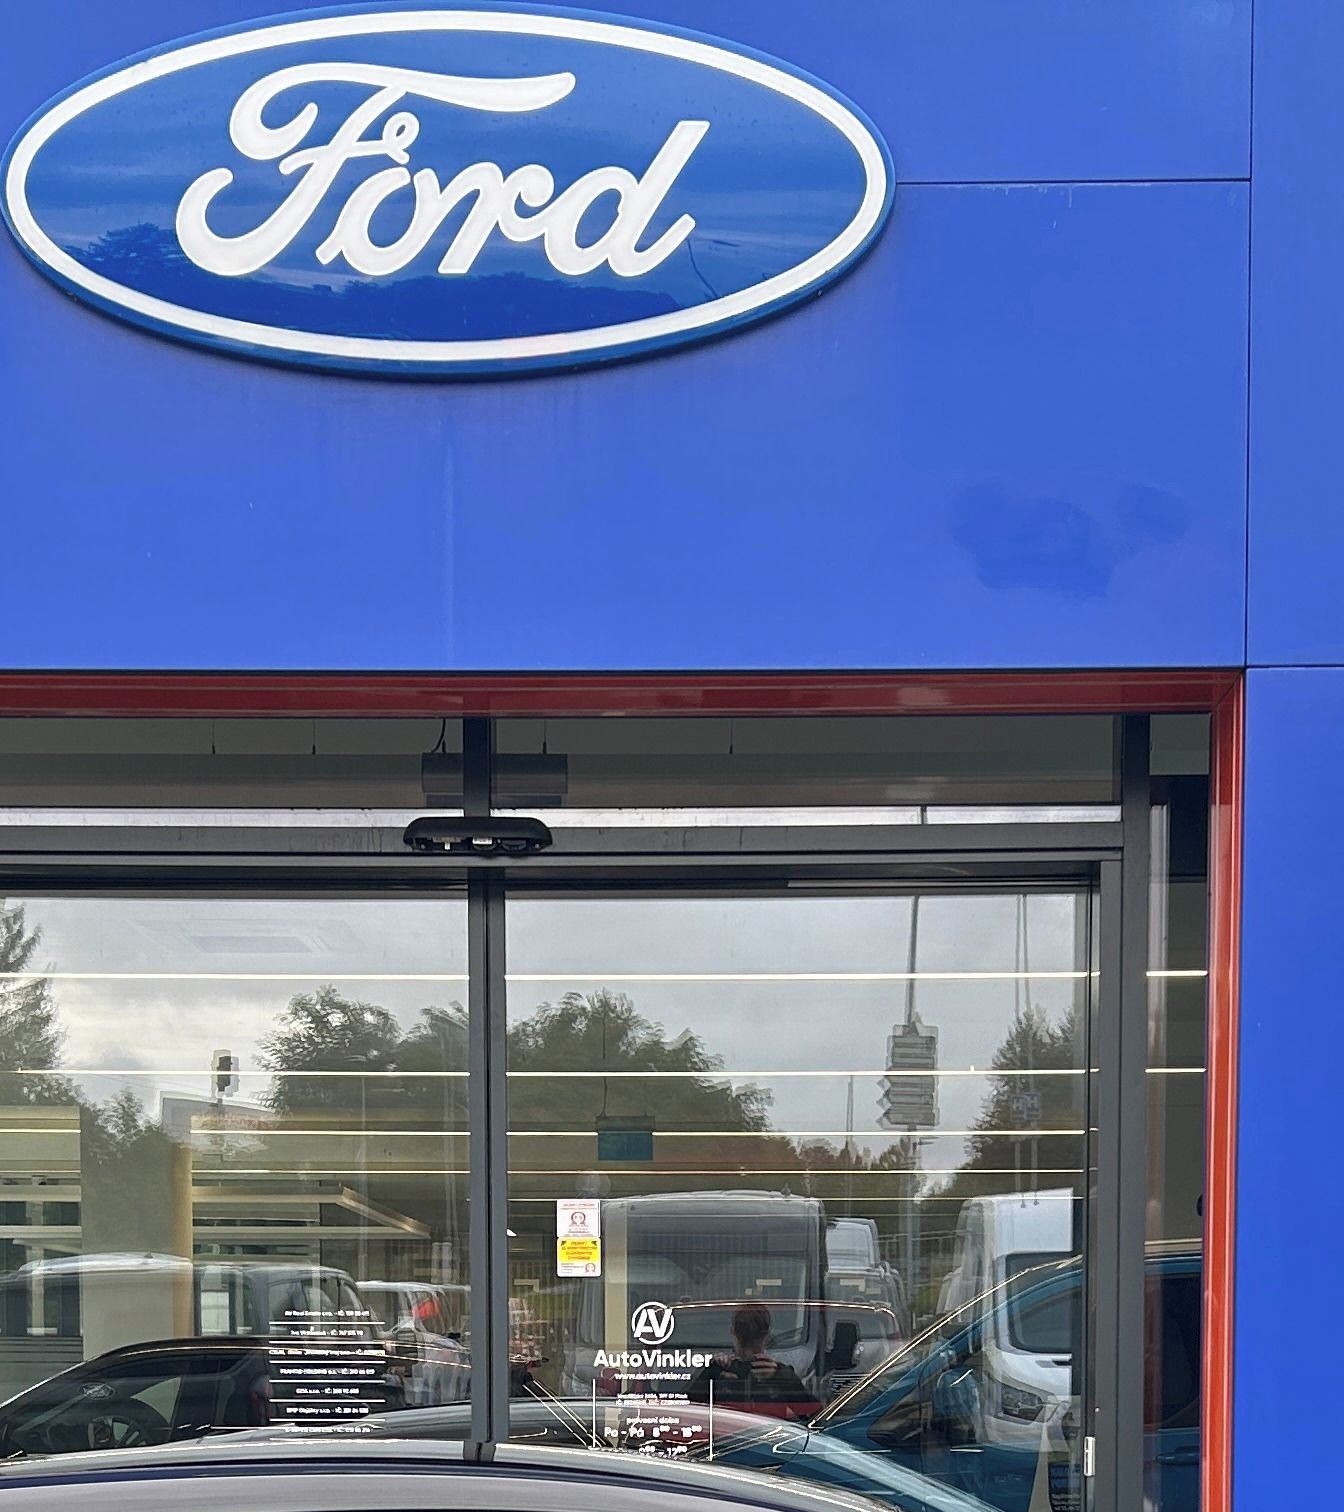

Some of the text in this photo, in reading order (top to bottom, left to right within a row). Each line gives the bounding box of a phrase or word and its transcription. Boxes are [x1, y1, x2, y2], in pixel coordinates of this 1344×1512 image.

[176, 62, 710, 277] Ford
[634, 1308, 672, 1337] AV
[593, 1349, 713, 1367] AutoVinkler
